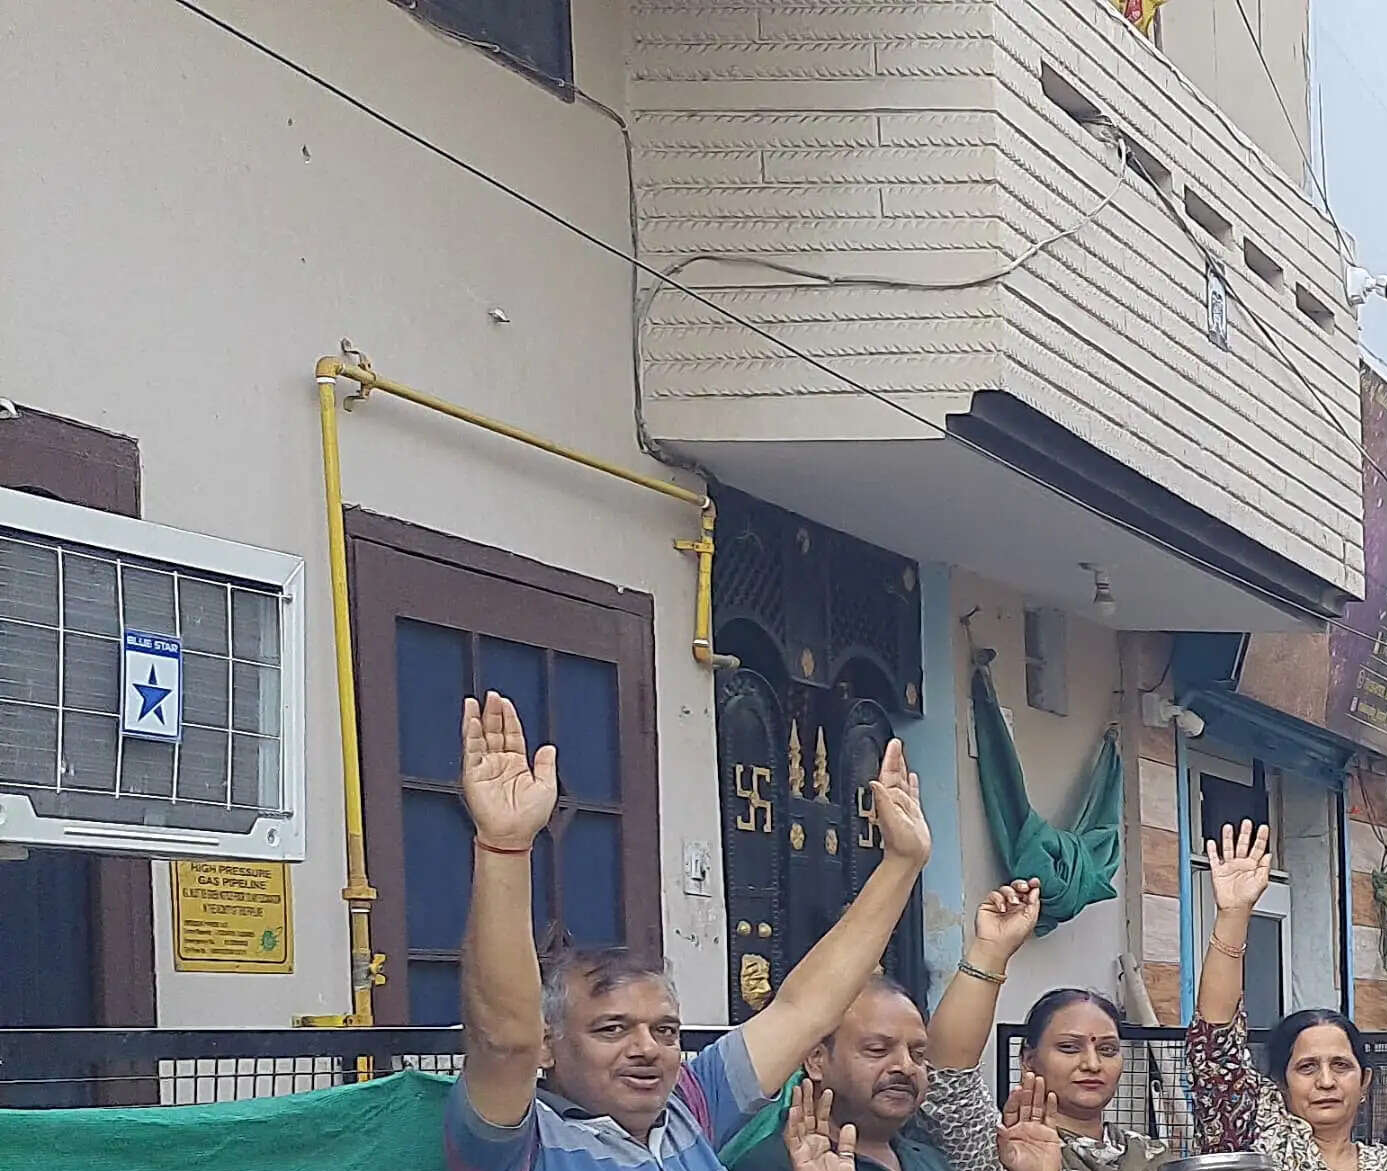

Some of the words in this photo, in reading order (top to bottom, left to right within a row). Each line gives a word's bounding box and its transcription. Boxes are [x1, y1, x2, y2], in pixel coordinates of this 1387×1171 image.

[127, 635, 152, 648] BLUE
[154, 640, 178, 653] STAR
[191, 863, 217, 873] HIGH
[219, 865, 272, 878] PRESSURE
[198, 875, 219, 887] GAS
[222, 877, 268, 890] PIPELINE
